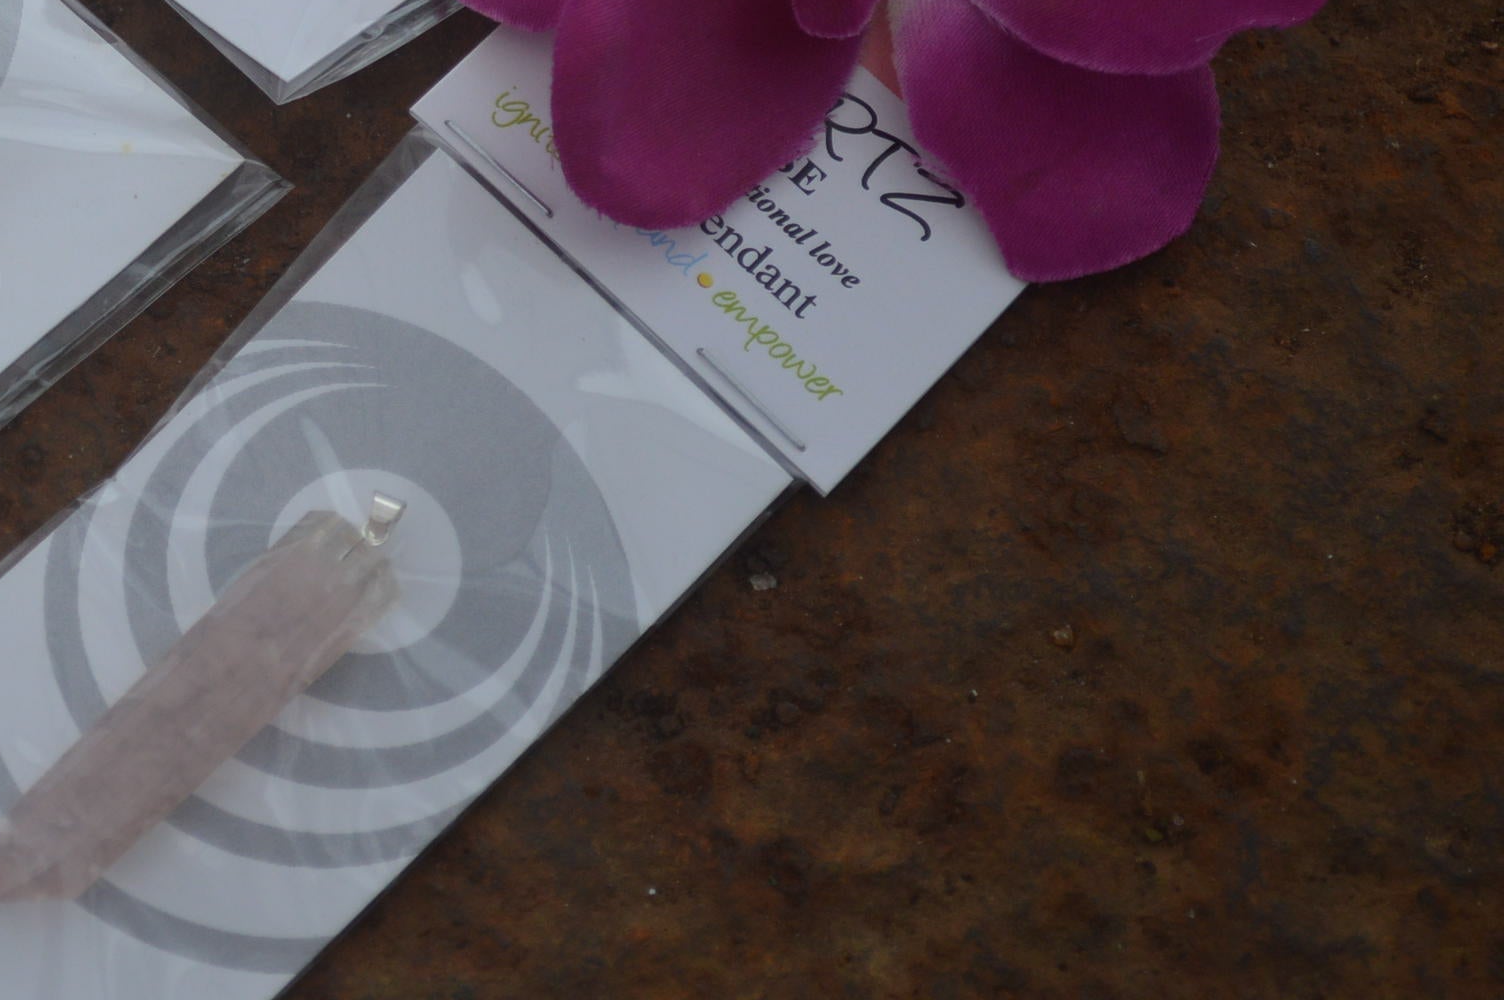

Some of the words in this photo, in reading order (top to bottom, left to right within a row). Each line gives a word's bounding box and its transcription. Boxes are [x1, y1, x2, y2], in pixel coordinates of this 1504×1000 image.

[699, 213, 818, 320] endant
[809, 240, 861, 289] love
[712, 290, 844, 402] empower
